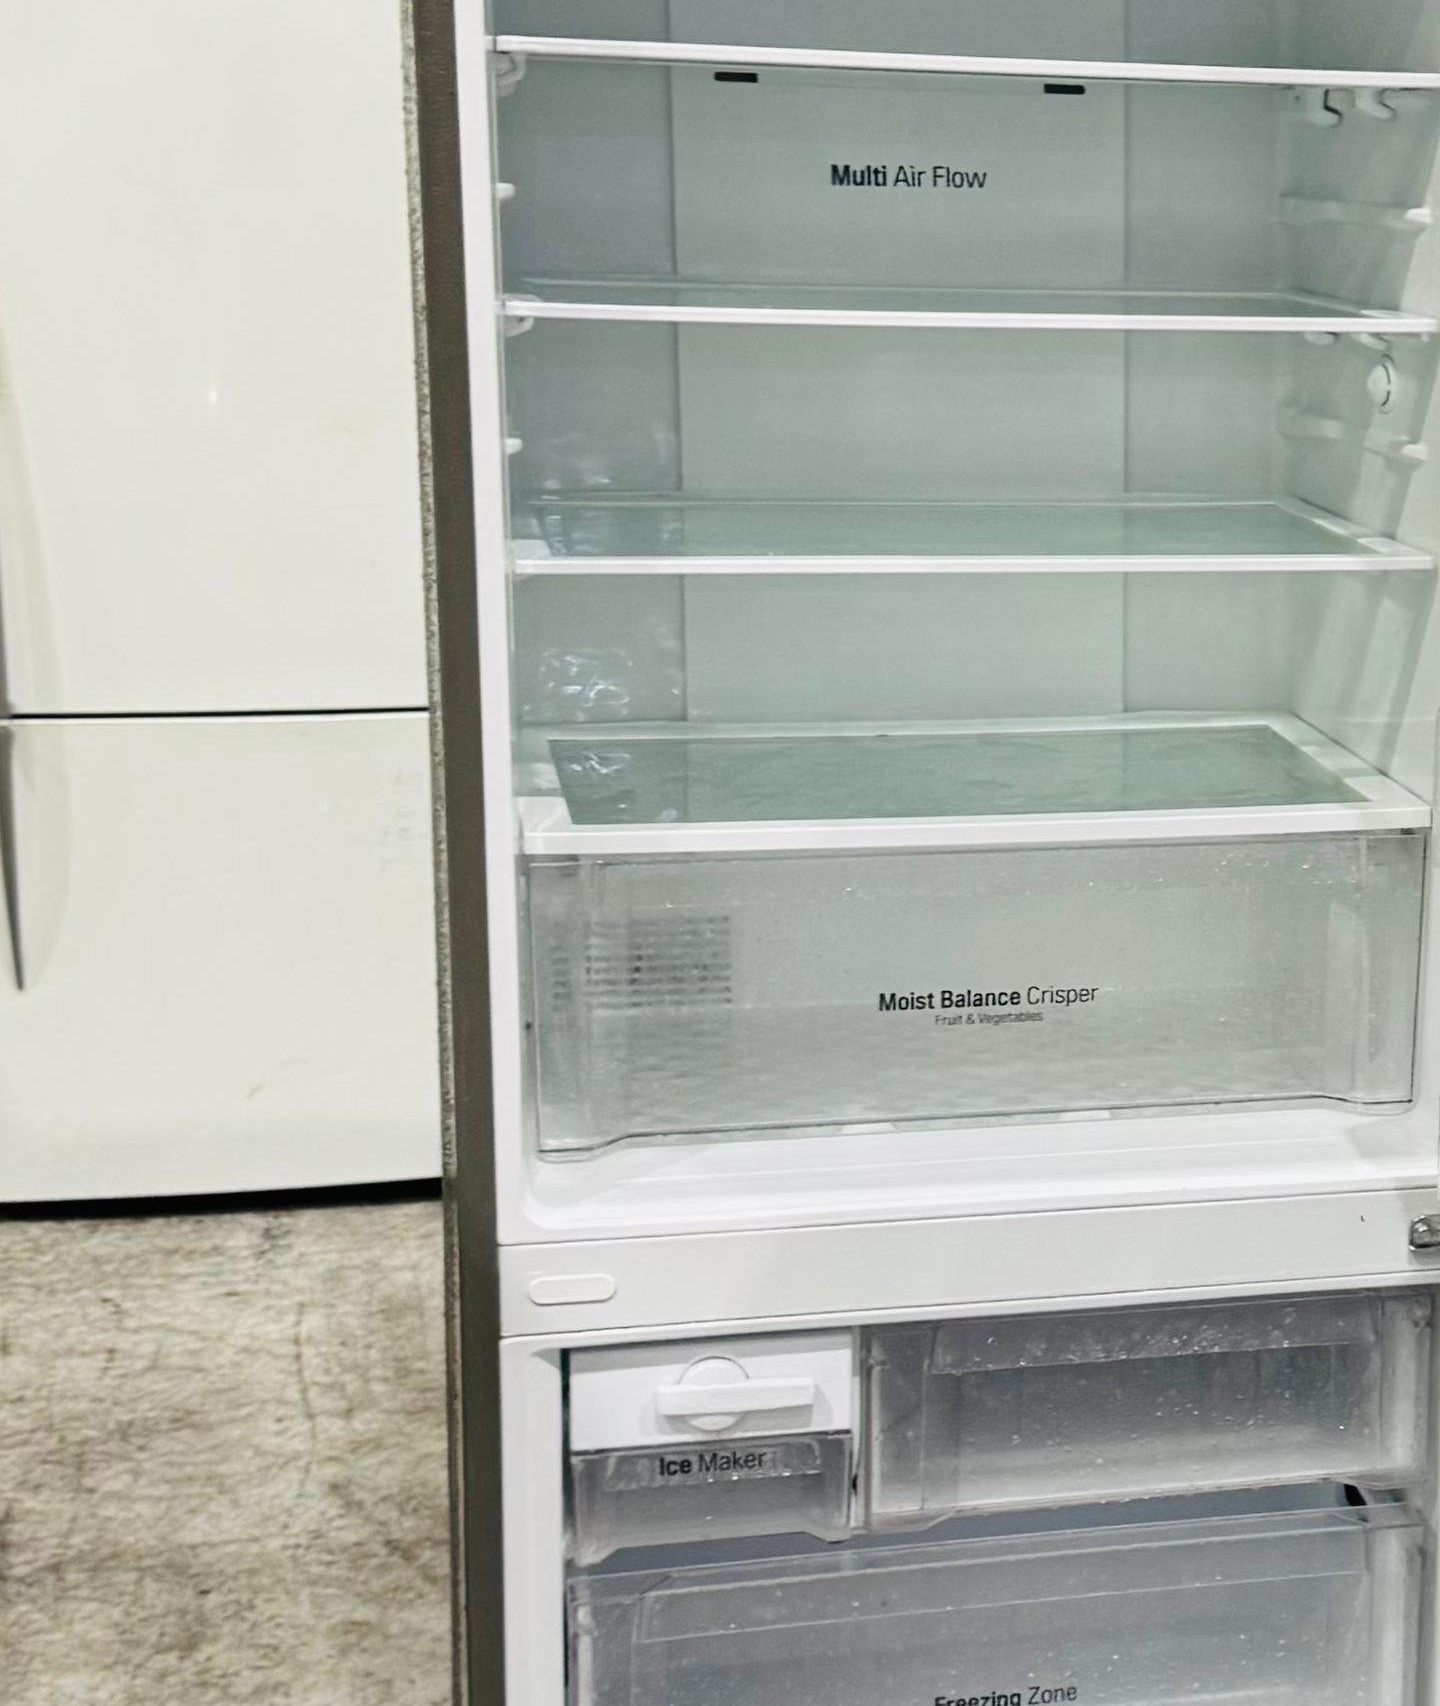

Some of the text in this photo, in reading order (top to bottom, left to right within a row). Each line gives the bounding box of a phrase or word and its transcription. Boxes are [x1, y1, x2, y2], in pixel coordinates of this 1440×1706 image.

[831, 164, 987, 188] Multi Air Flow
[879, 985, 1099, 1011] Moist Balance Crisper
[935, 1011, 1044, 1026] Fruit & Vegetables
[659, 1451, 768, 1476] Ice Maker
[1028, 1686, 1077, 1705] Zone
